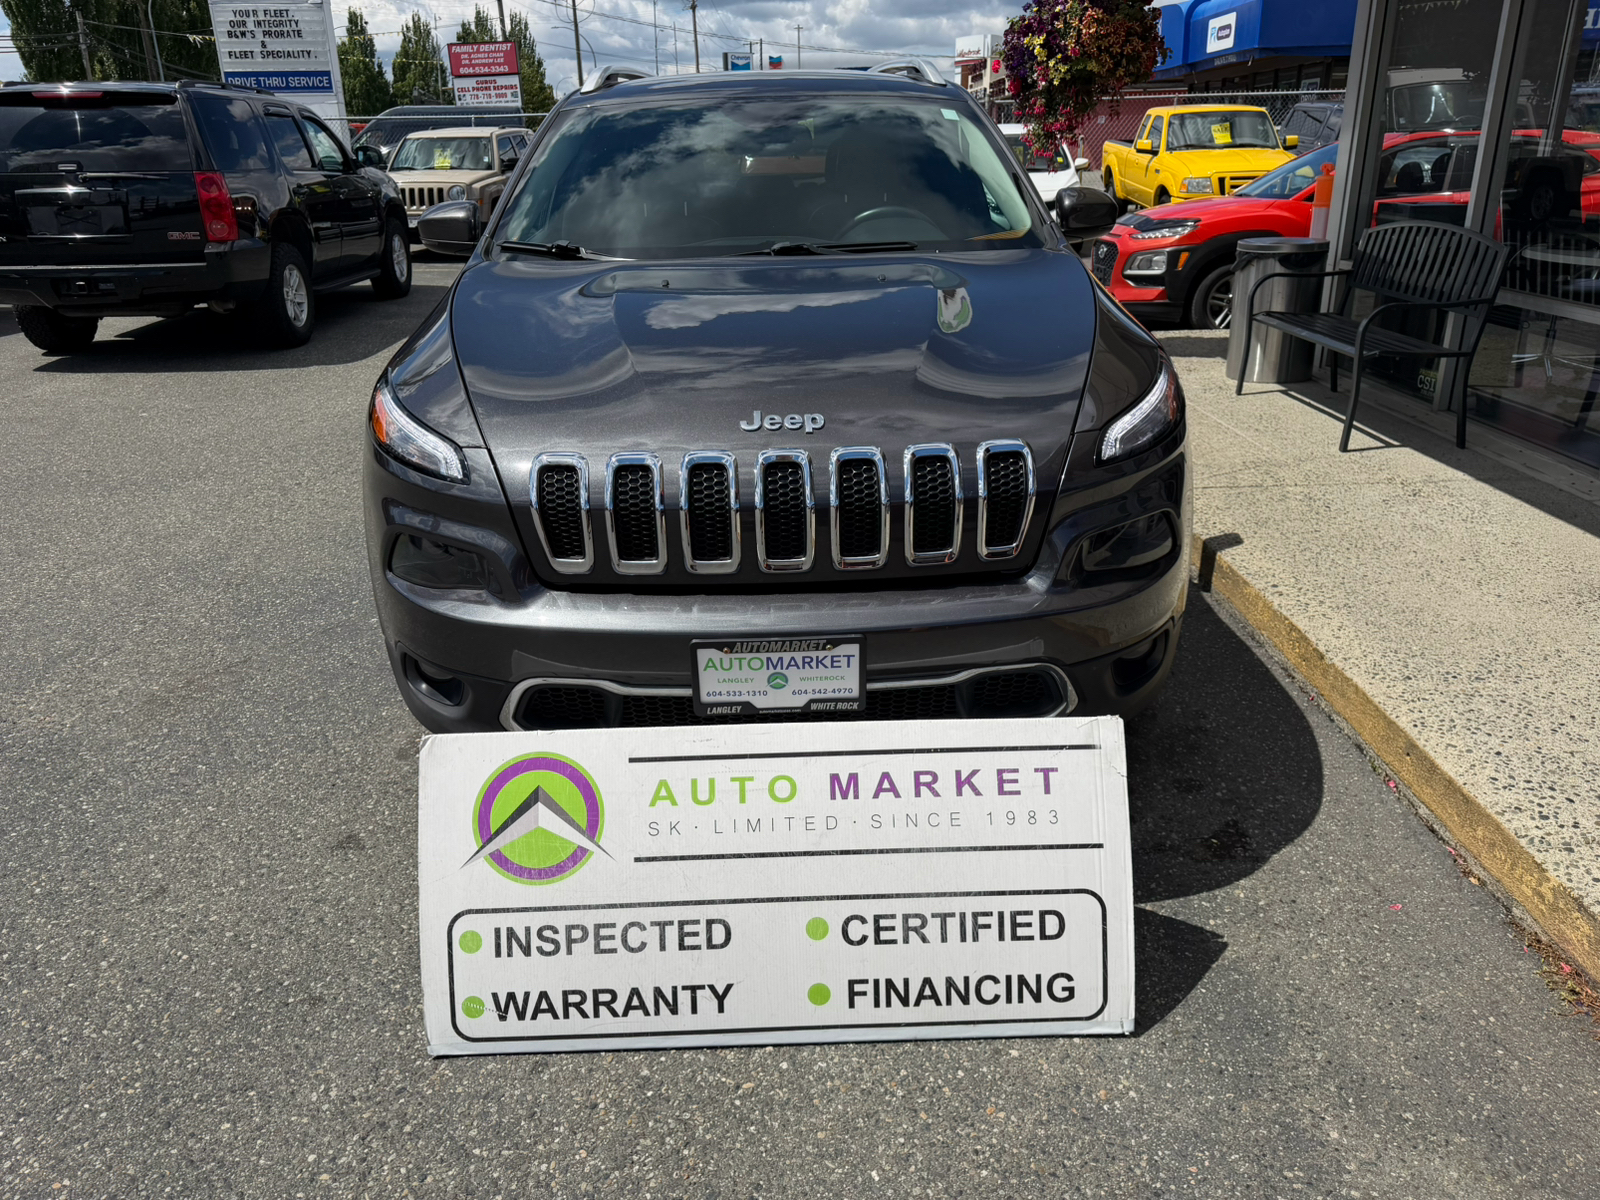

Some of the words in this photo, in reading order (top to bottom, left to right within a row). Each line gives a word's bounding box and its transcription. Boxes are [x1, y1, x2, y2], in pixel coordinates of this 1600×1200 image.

[232, 9, 258, 18] YOUR
[229, 19, 247, 29] OUR
[253, 19, 299, 28] INTEGRITY
[227, 29, 256, 39] B&W'S
[262, 29, 303, 38] PRORATE
[260, 40, 267, 49] &
[480, 44, 511, 52] DENTIST
[228, 50, 254, 59] FLEET
[459, 65, 509, 74] 604-534-3343
[227, 77, 258, 88] DRIVE
[258, 77, 286, 88] THRU
[288, 76, 330, 87] SERVICE
[492, 83, 518, 91] REPAIRS
[166, 231, 200, 240] GMC
[1417, 374, 1436, 392] CSI
[739, 410, 825, 435] Jeep
[732, 639, 827, 654] AUTOMARKET
[703, 654, 856, 672] AUTOMARKET
[706, 690, 768, 698] 604-533-1310
[791, 687, 854, 696] 604-542-4970
[707, 705, 743, 715] LANGLEY
[810, 703, 836, 711] WHITE
[836, 702, 860, 710] ROCK
[648, 774, 799, 807] AUTO
[829, 767, 1060, 801] MARKET
[647, 820, 683, 837] SK
[713, 815, 840, 834] LIMITED
[870, 811, 963, 829] SINCE
[985, 809, 1061, 827] 1983
[841, 909, 1067, 945] CERTIFIED
[494, 918, 732, 958] INSPECTED
[847, 972, 1077, 1010] FINANCING
[492, 983, 735, 1022] WARRANTY
